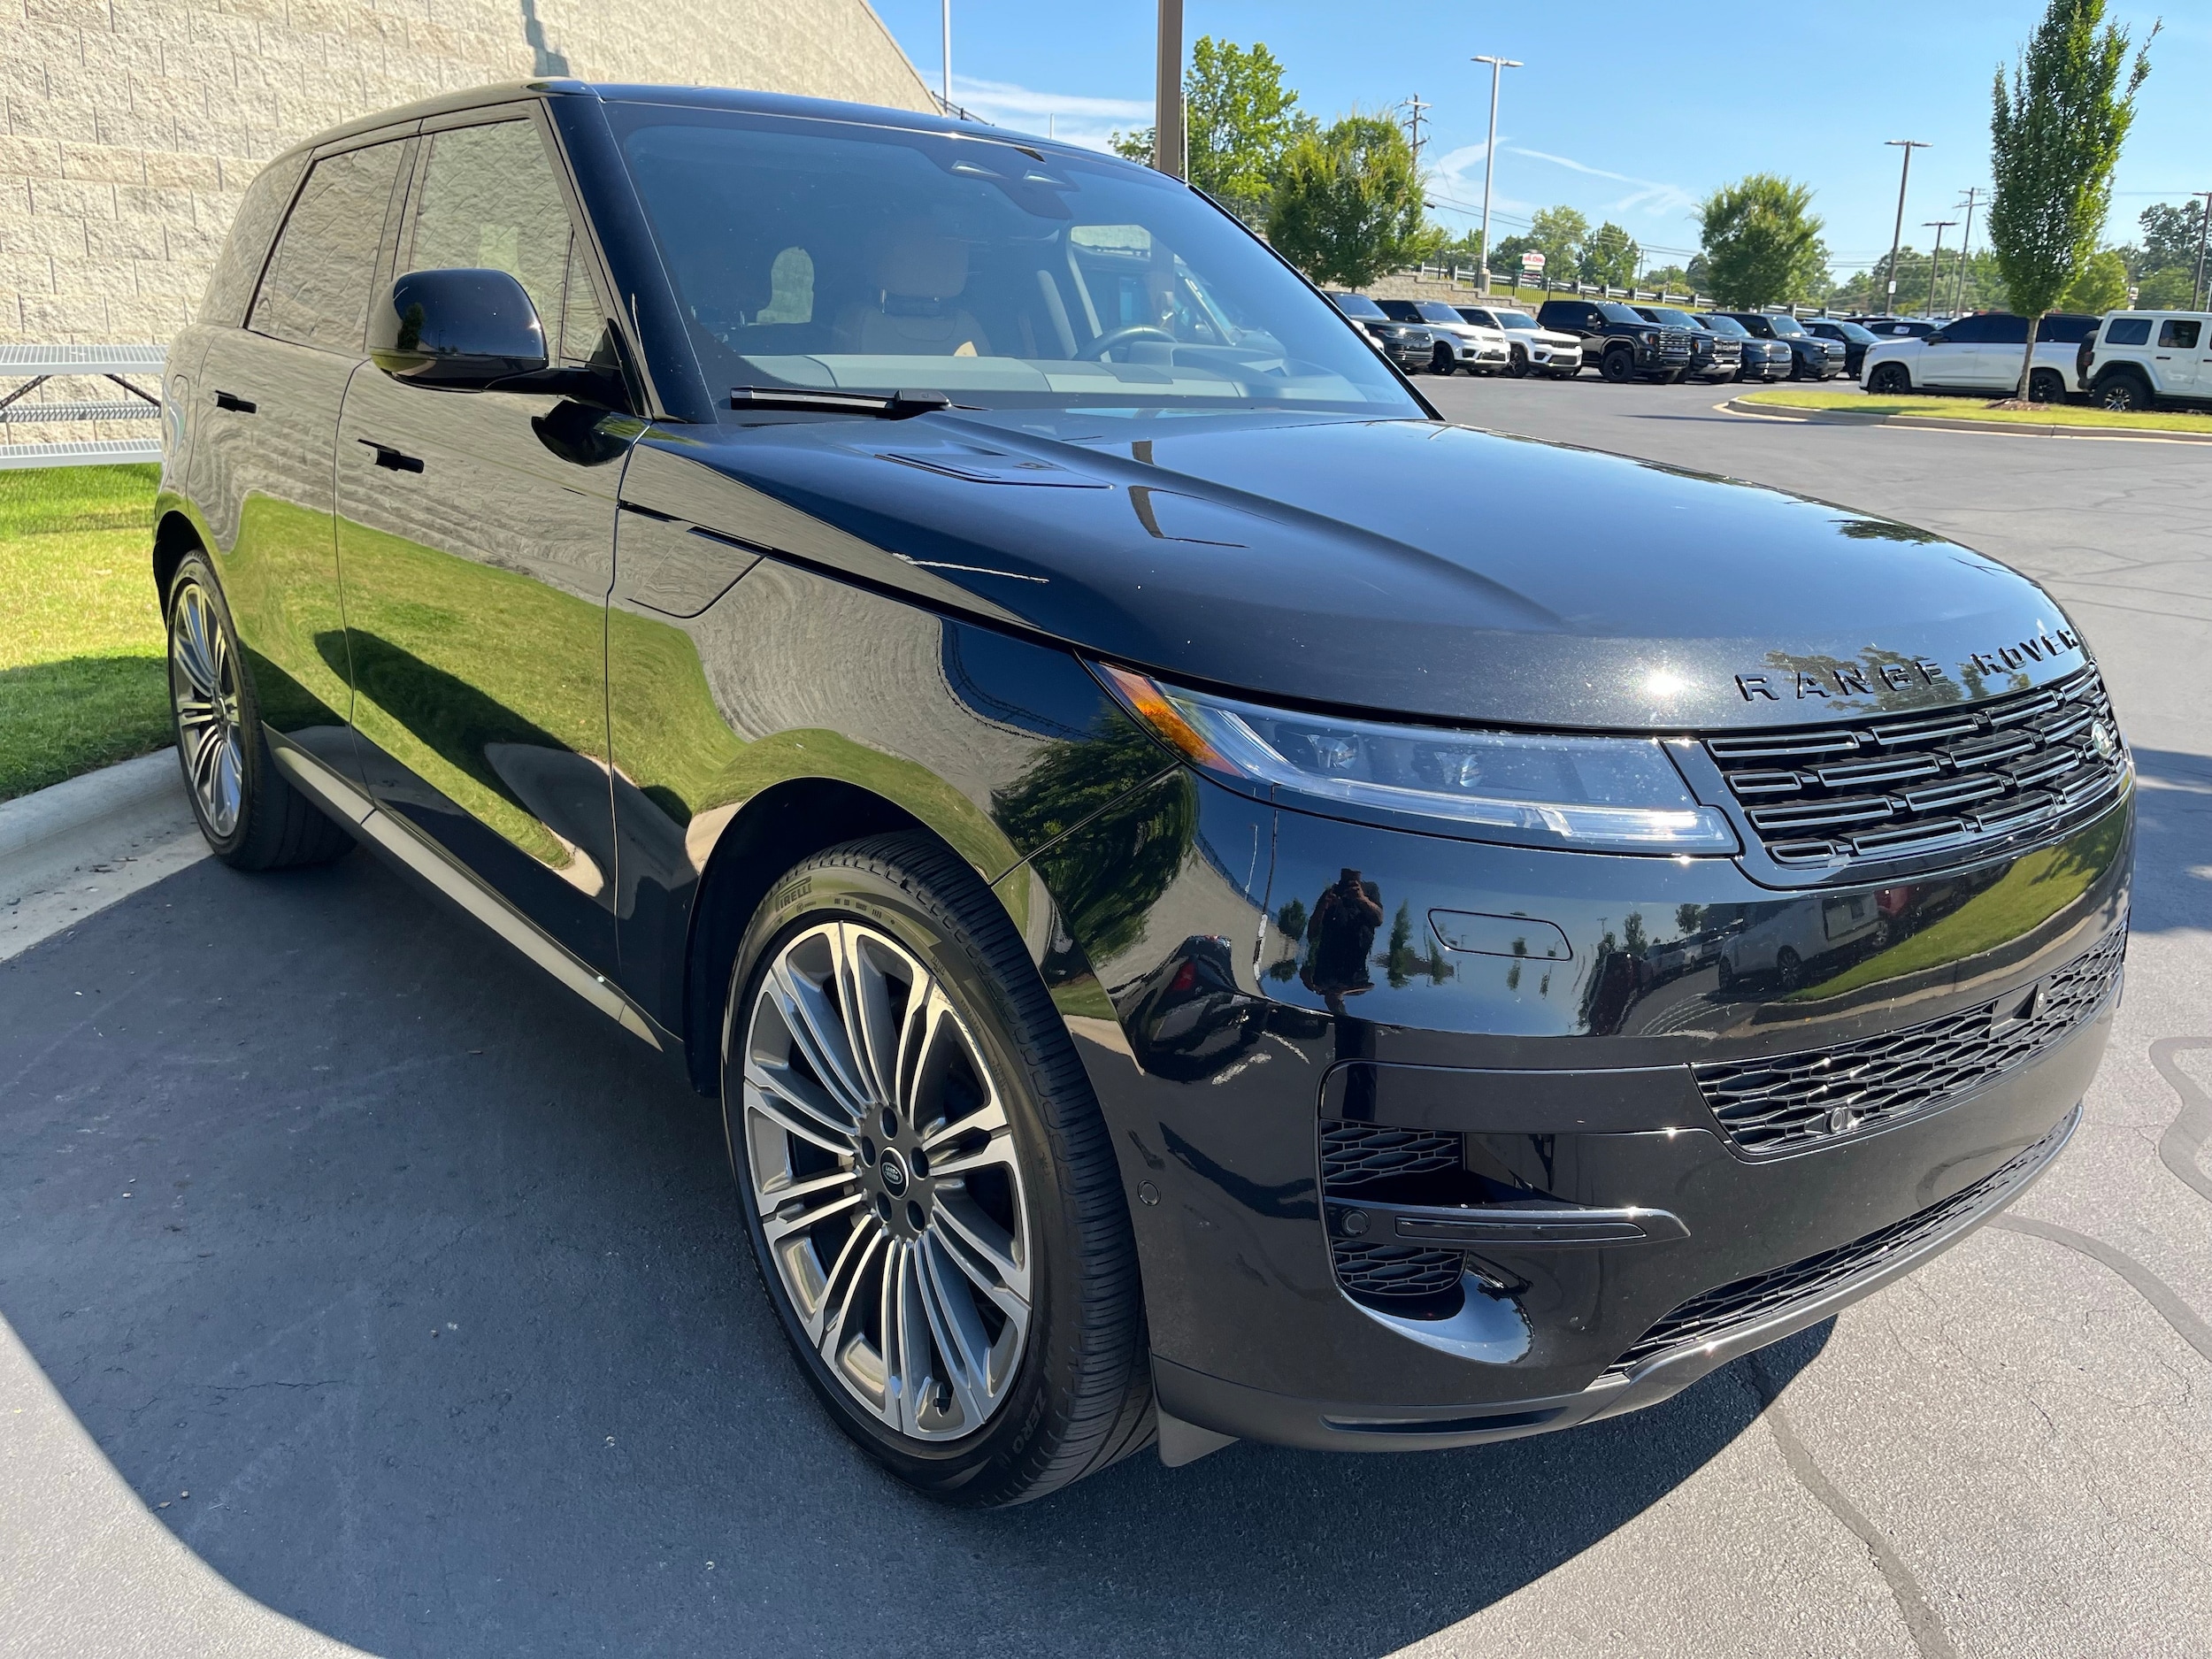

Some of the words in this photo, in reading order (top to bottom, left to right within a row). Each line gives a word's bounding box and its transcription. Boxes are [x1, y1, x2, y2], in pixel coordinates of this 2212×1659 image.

[1734, 660, 1947, 702] RANGE
[1970, 628, 2079, 676] ROVER
[776, 876, 812, 912] PIRELLI
[1012, 1386, 1047, 1454] ZERO
